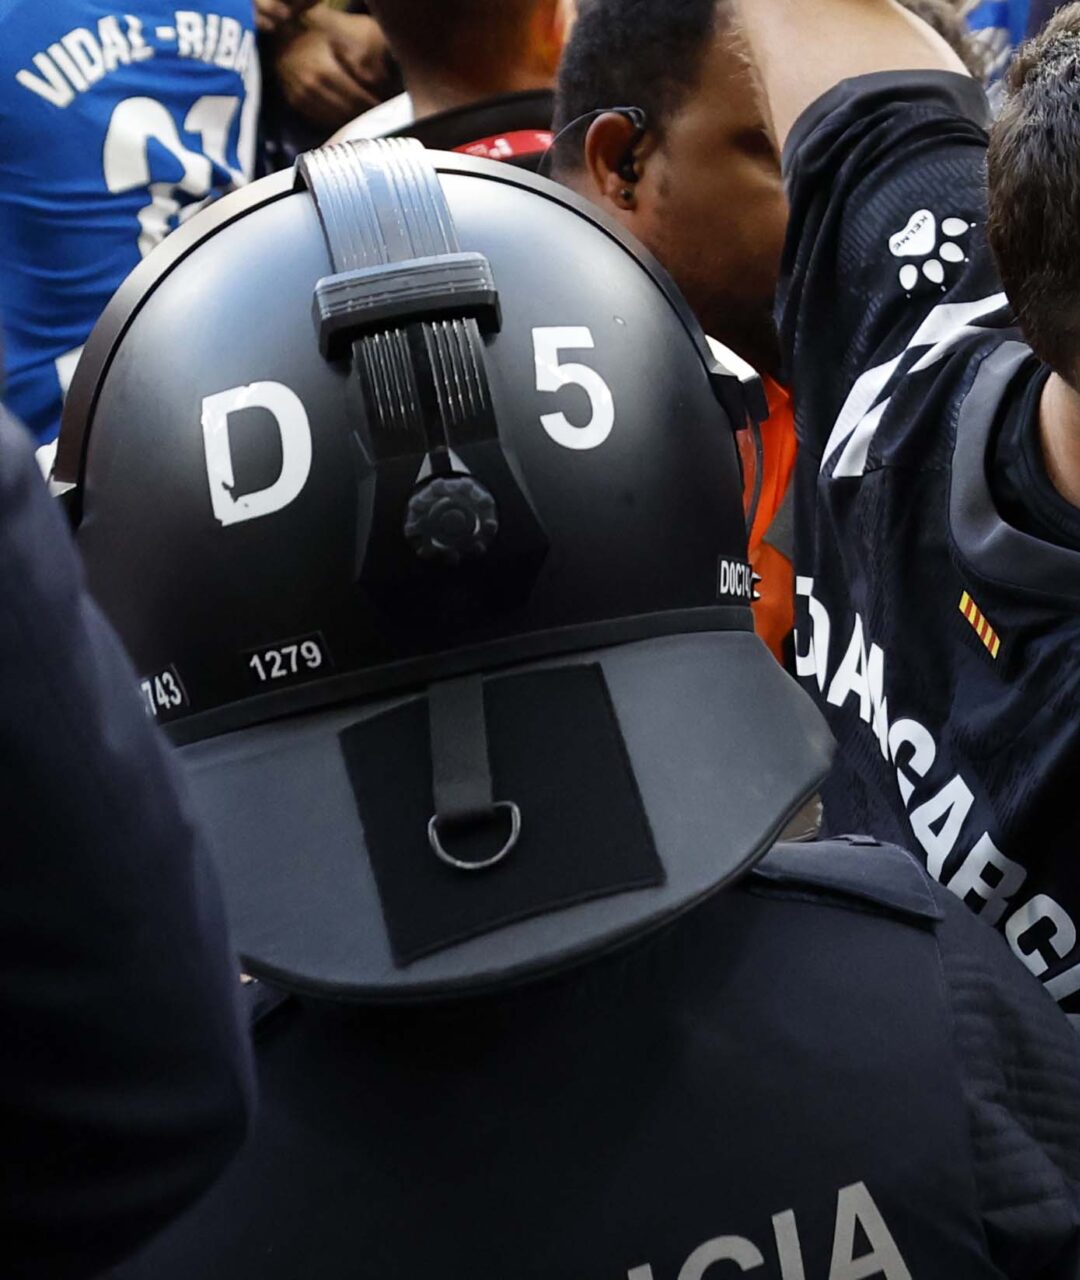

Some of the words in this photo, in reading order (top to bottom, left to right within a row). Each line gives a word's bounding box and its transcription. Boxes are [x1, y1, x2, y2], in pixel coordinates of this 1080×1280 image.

[201, 380, 313, 527] D
[532, 325, 615, 451] 5
[250, 640, 322, 681] 1279
